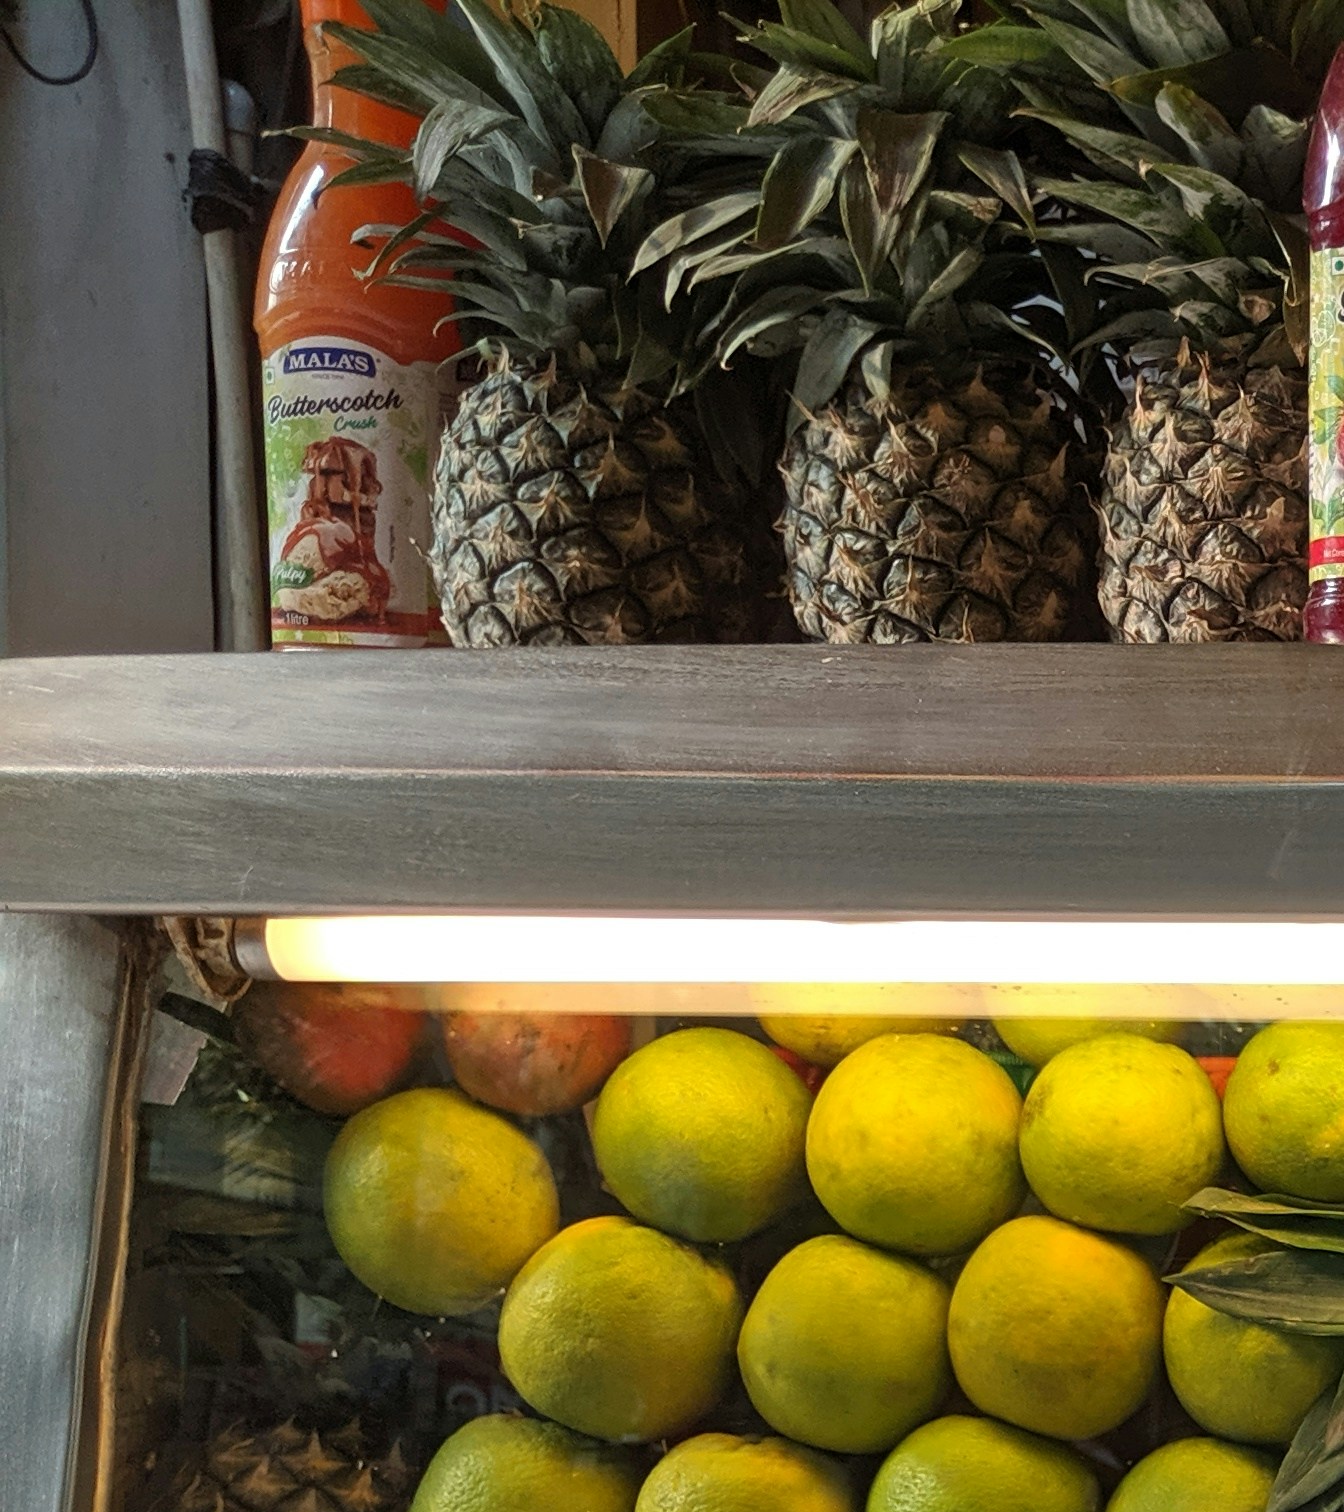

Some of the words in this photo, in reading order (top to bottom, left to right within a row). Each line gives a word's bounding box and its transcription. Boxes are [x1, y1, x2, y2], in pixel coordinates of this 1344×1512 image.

[288, 352, 370, 372] MALA'S
[268, 387, 405, 424] Butterscotch
[333, 415, 379, 432] Crush
[275, 566, 306, 583] Pulpy
